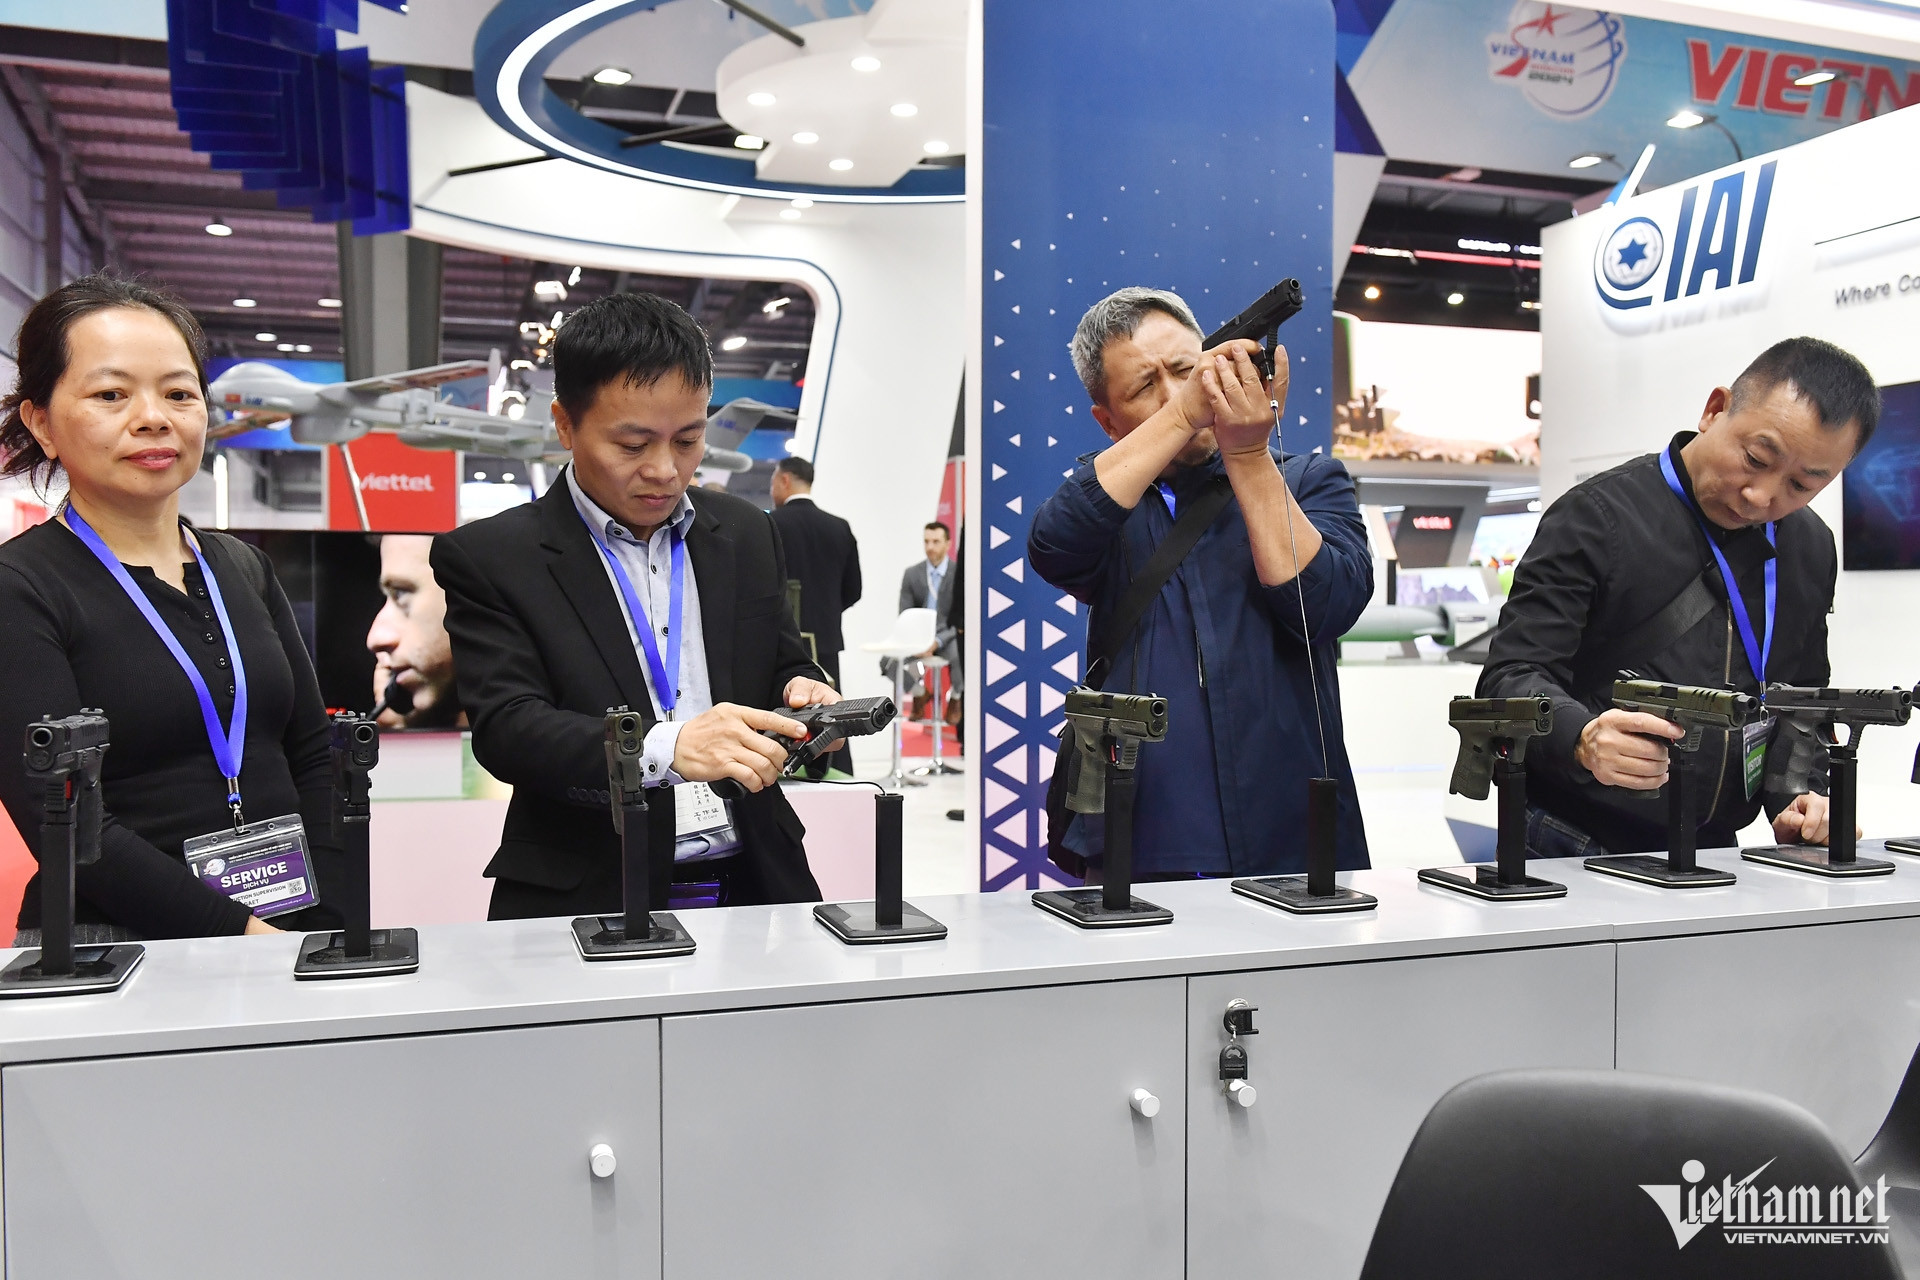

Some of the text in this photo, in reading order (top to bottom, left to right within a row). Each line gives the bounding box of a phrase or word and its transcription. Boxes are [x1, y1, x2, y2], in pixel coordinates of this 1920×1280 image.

[1491, 41, 1575, 64] VIETNAM
[1663, 160, 1778, 302] IAI
[1835, 283, 1890, 305] Where
[220, 861, 288, 888] SERVICE
[242, 881, 260, 890] DỊCH
[253, 885, 287, 897] SUPERVISION
